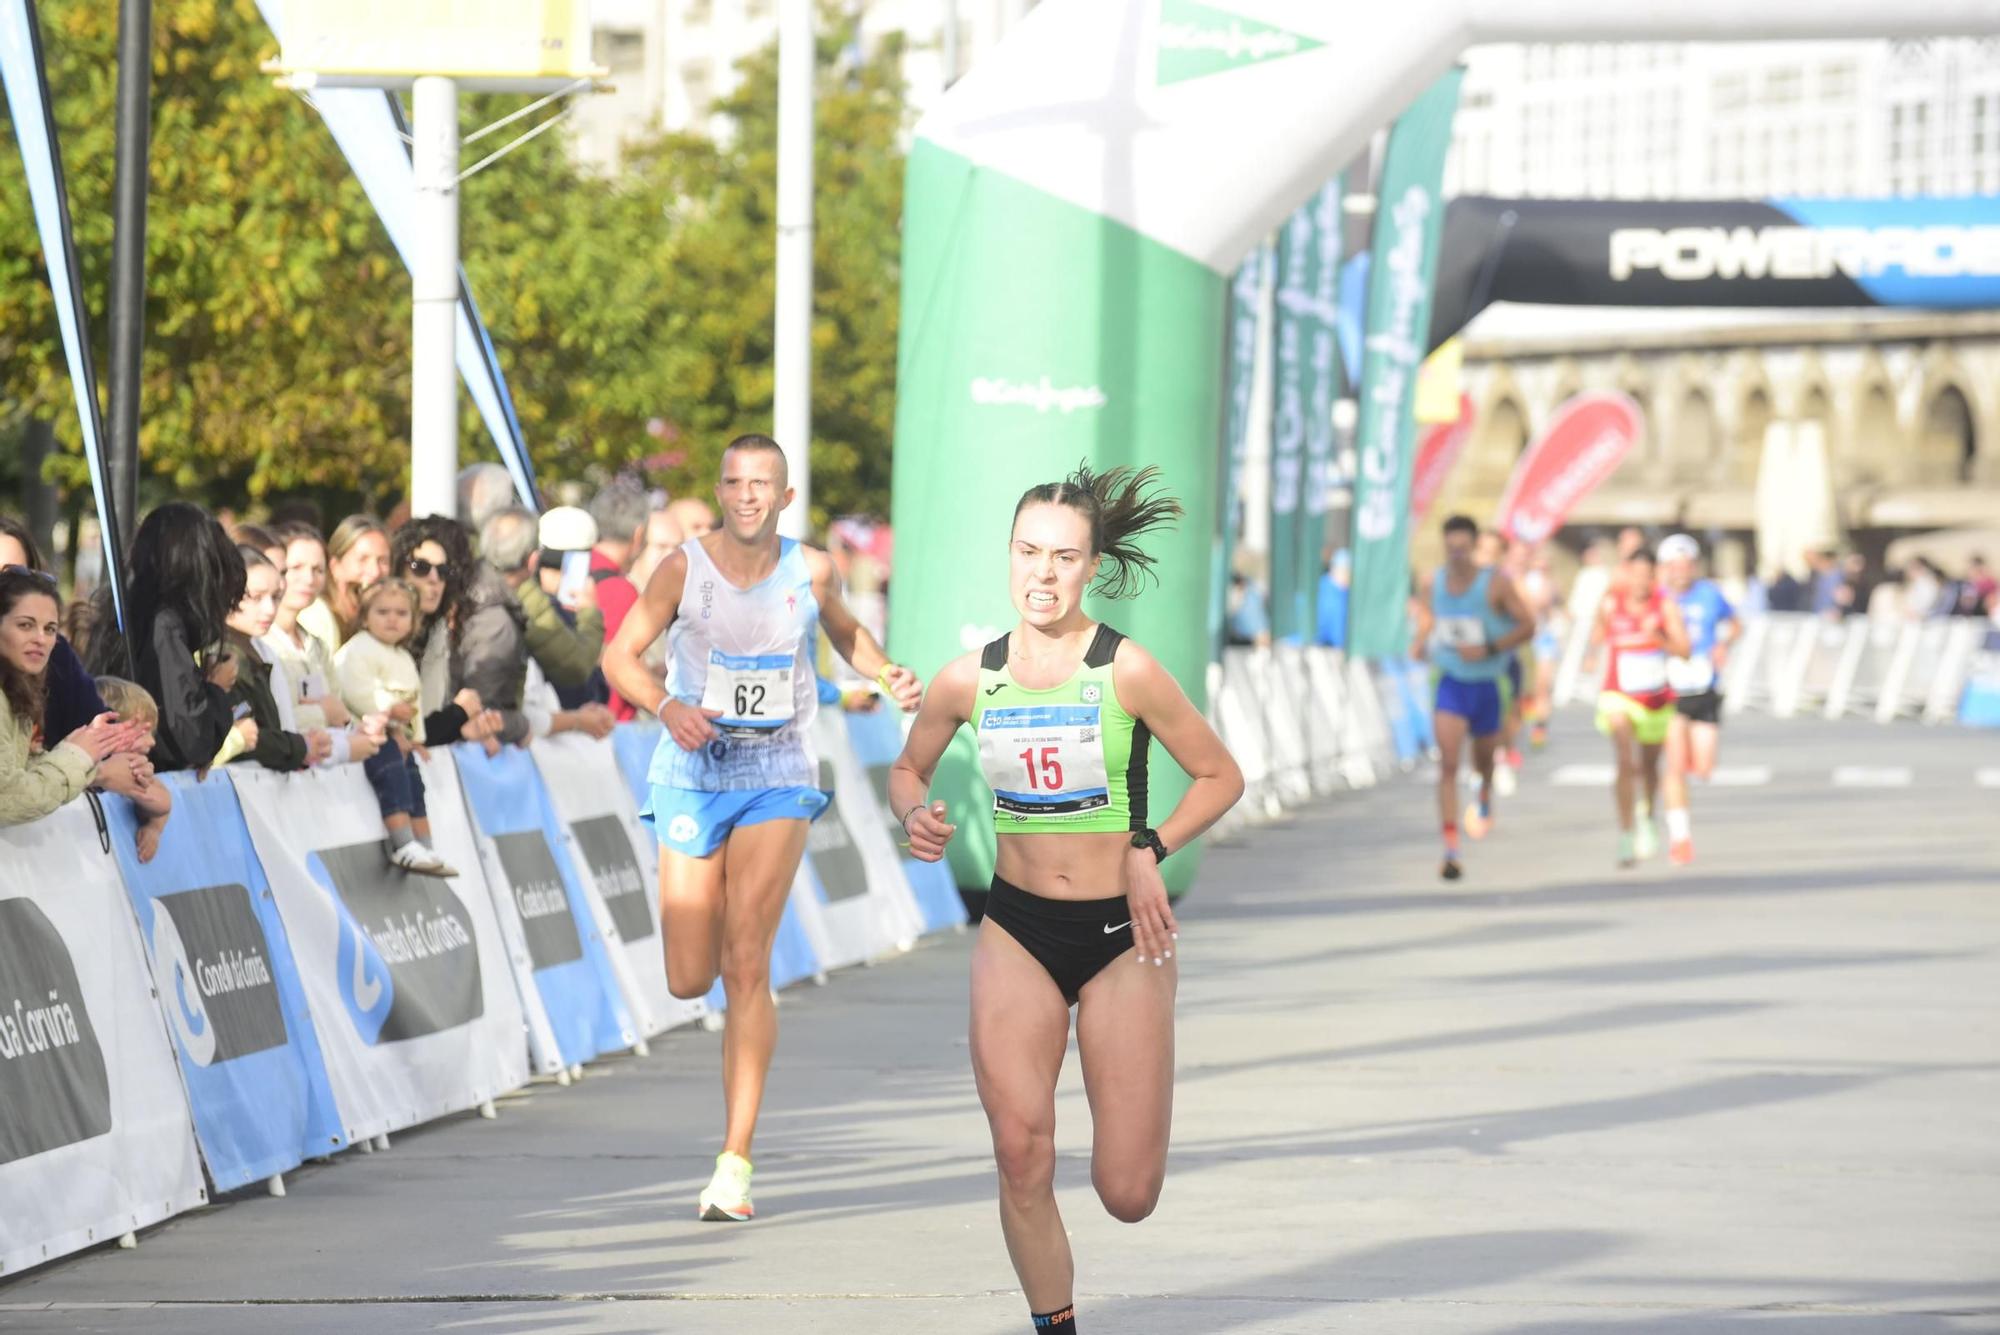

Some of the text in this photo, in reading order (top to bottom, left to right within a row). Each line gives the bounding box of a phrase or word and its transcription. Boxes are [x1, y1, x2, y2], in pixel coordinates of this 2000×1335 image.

[734, 685, 766, 716] 62
[1019, 747, 1063, 790] 15
[14, 989, 80, 1053] Coruña
